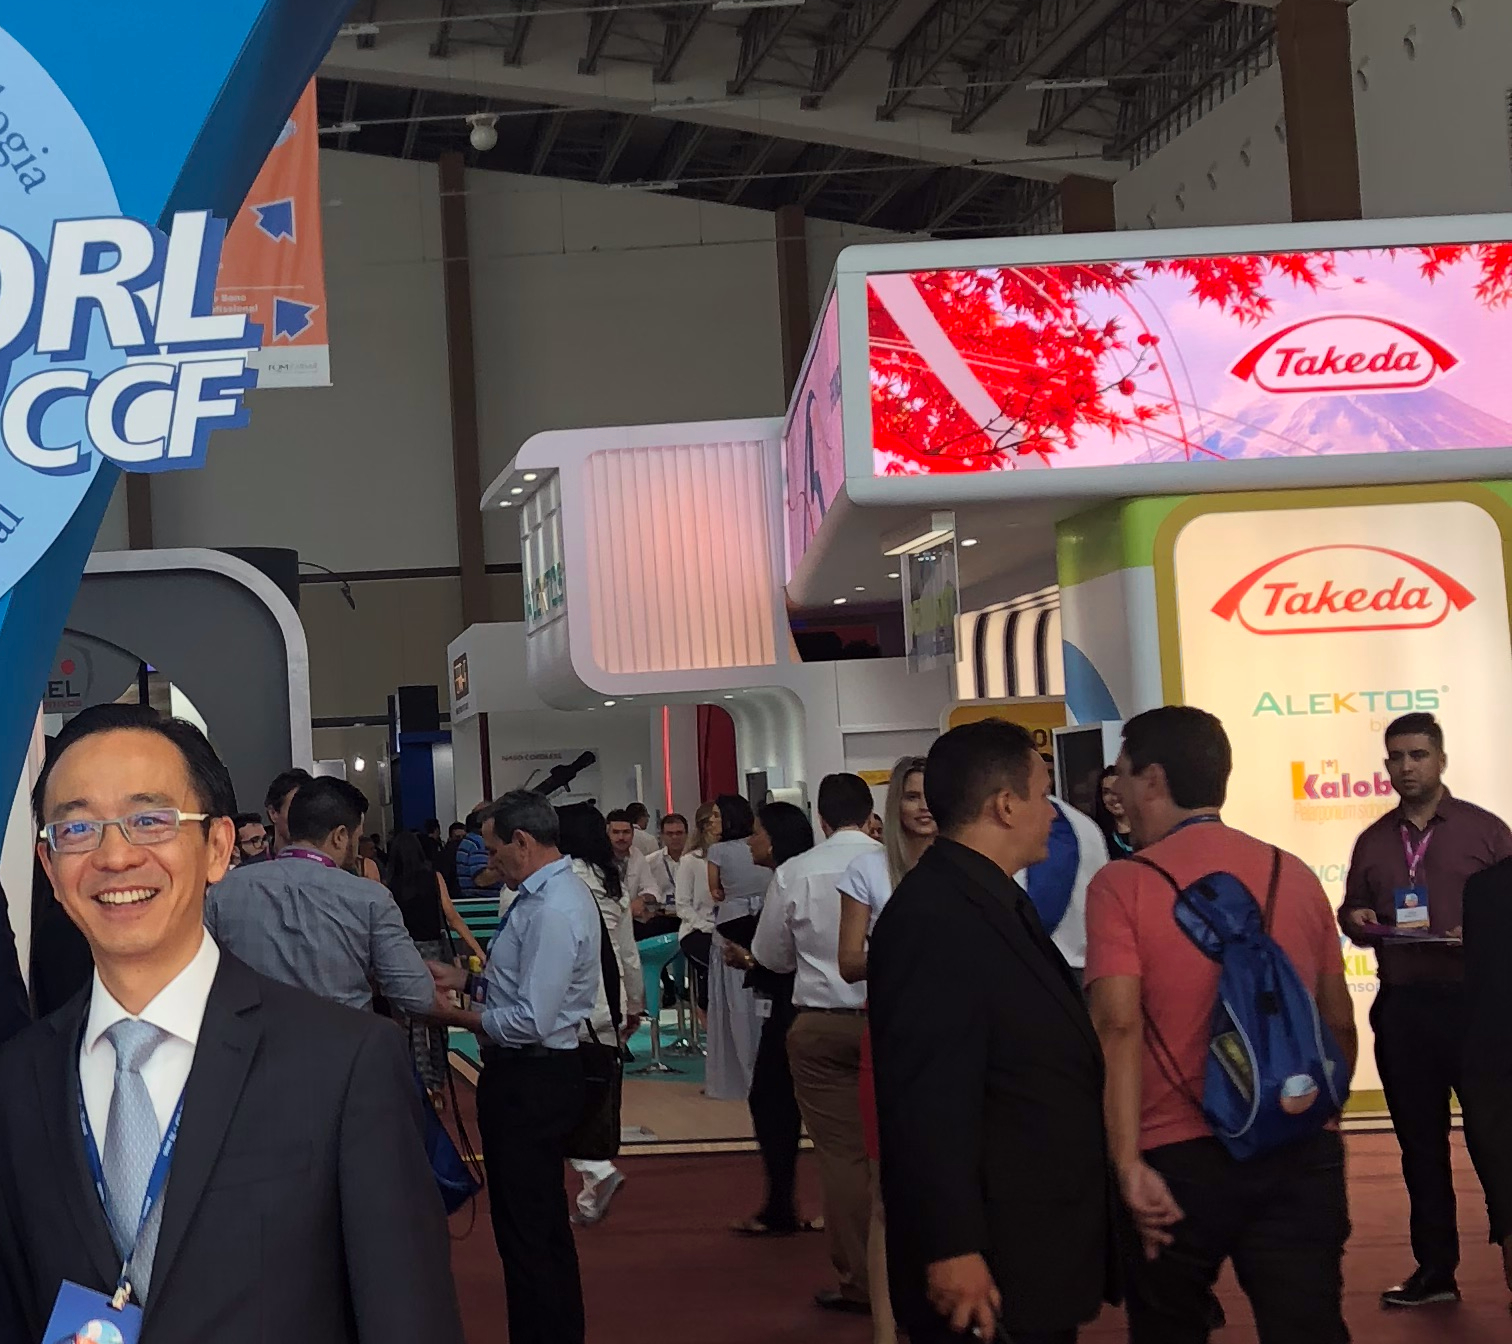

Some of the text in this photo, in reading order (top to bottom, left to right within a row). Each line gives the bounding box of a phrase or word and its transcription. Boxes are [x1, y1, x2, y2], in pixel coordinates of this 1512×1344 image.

[1275, 342, 1421, 377] Takeda
[3, 360, 243, 467] CCF
[1263, 577, 1433, 617] Takeda
